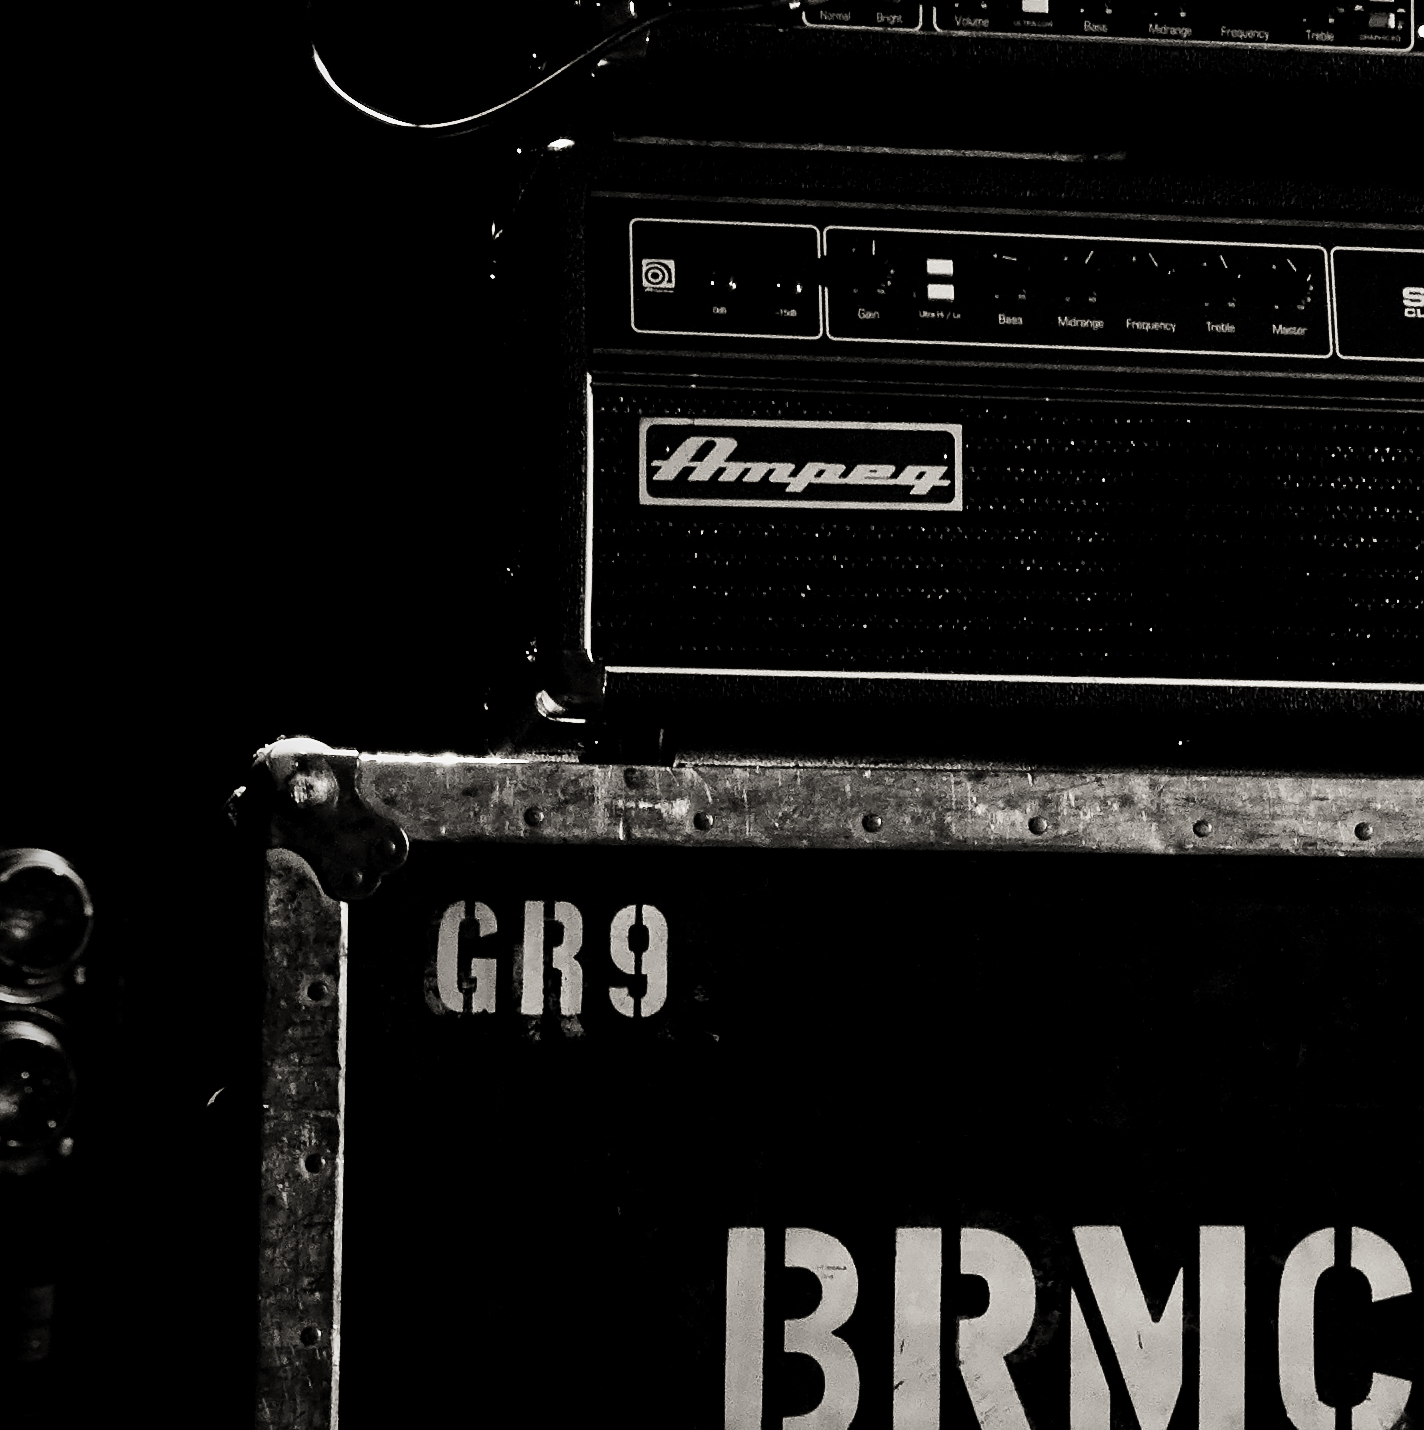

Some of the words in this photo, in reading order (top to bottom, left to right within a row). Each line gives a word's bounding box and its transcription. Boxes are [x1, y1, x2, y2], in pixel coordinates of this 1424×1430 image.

[819, 9, 851, 22] Normal
[876, 11, 903, 25] Bright
[954, 14, 990, 29] Volume
[1083, 19, 1109, 34] Bass
[1149, 22, 1193, 38] Midrange
[1220, 25, 1270, 41] Frequency
[1305, 27, 1335, 43] Treble
[858, 307, 880, 320] Gain
[998, 313, 1024, 326] Bass
[1057, 315, 1105, 331] Midrange
[1126, 317, 1177, 333] Frequency
[1206, 320, 1236, 334] Treble
[1272, 323, 1309, 337] Master
[650, 436, 951, 495] Ampeg
[436, 900, 669, 1018] GR9
